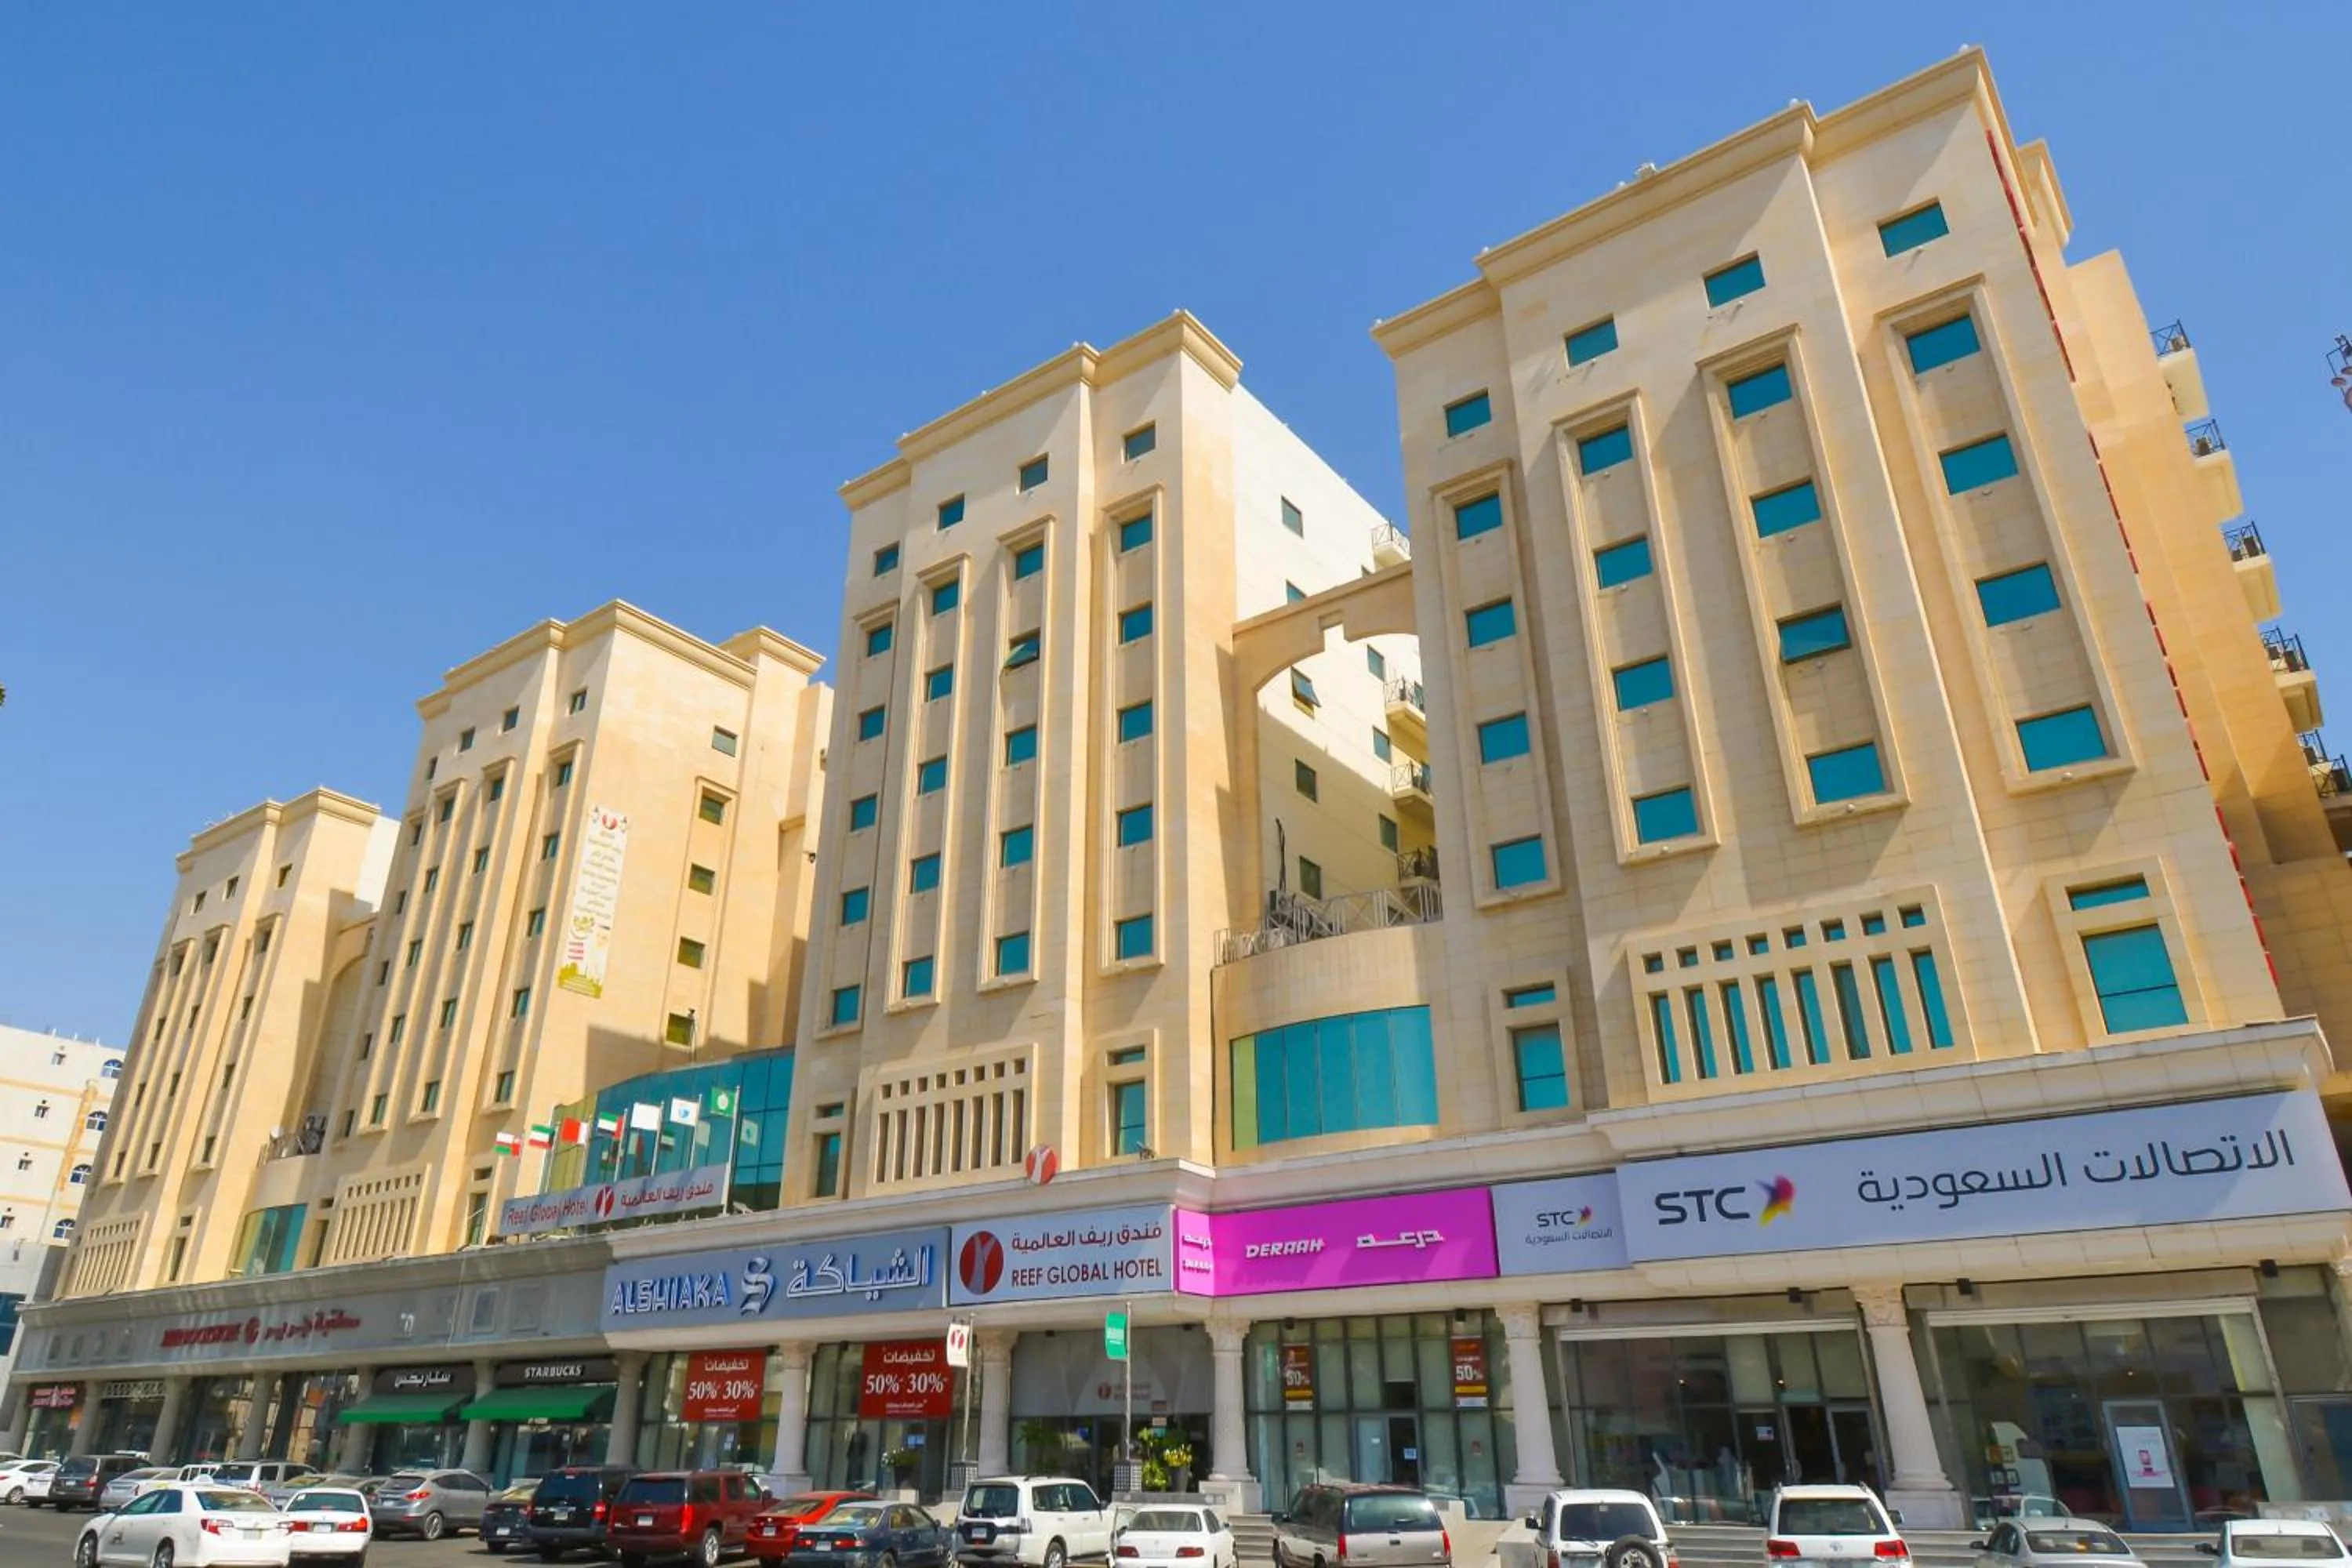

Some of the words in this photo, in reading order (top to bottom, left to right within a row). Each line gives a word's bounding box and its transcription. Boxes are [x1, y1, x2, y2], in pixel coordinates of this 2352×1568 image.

[2084, 1129, 2294, 1183] الاتصالات
[1857, 1152, 2067, 1210] السعودية
[1655, 1185, 1750, 1225] STC
[1537, 1210, 1575, 1228] STC
[1012, 1229, 1075, 1254] العالمية
[1080, 1225, 1112, 1247] ريف
[1117, 1221, 1162, 1247] فندق
[1525, 1232, 1570, 1246] السعودية
[1572, 1228, 1613, 1240] الاتصالات
[1246, 1238, 1325, 1258] DERAAH
[786, 1246, 931, 1301] الشياكة
[1011, 1268, 1044, 1287] REEF
[1047, 1262, 1109, 1284] GLOBAL
[1114, 1258, 1162, 1279] HOTEL
[611, 1272, 731, 1315] ALSHIAKA
[704, 1357, 750, 1373] تخفيضات
[883, 1348, 935, 1365] تخفيضات
[524, 1365, 582, 1378] STARBUCKS
[1456, 1365, 1484, 1381] 50%
